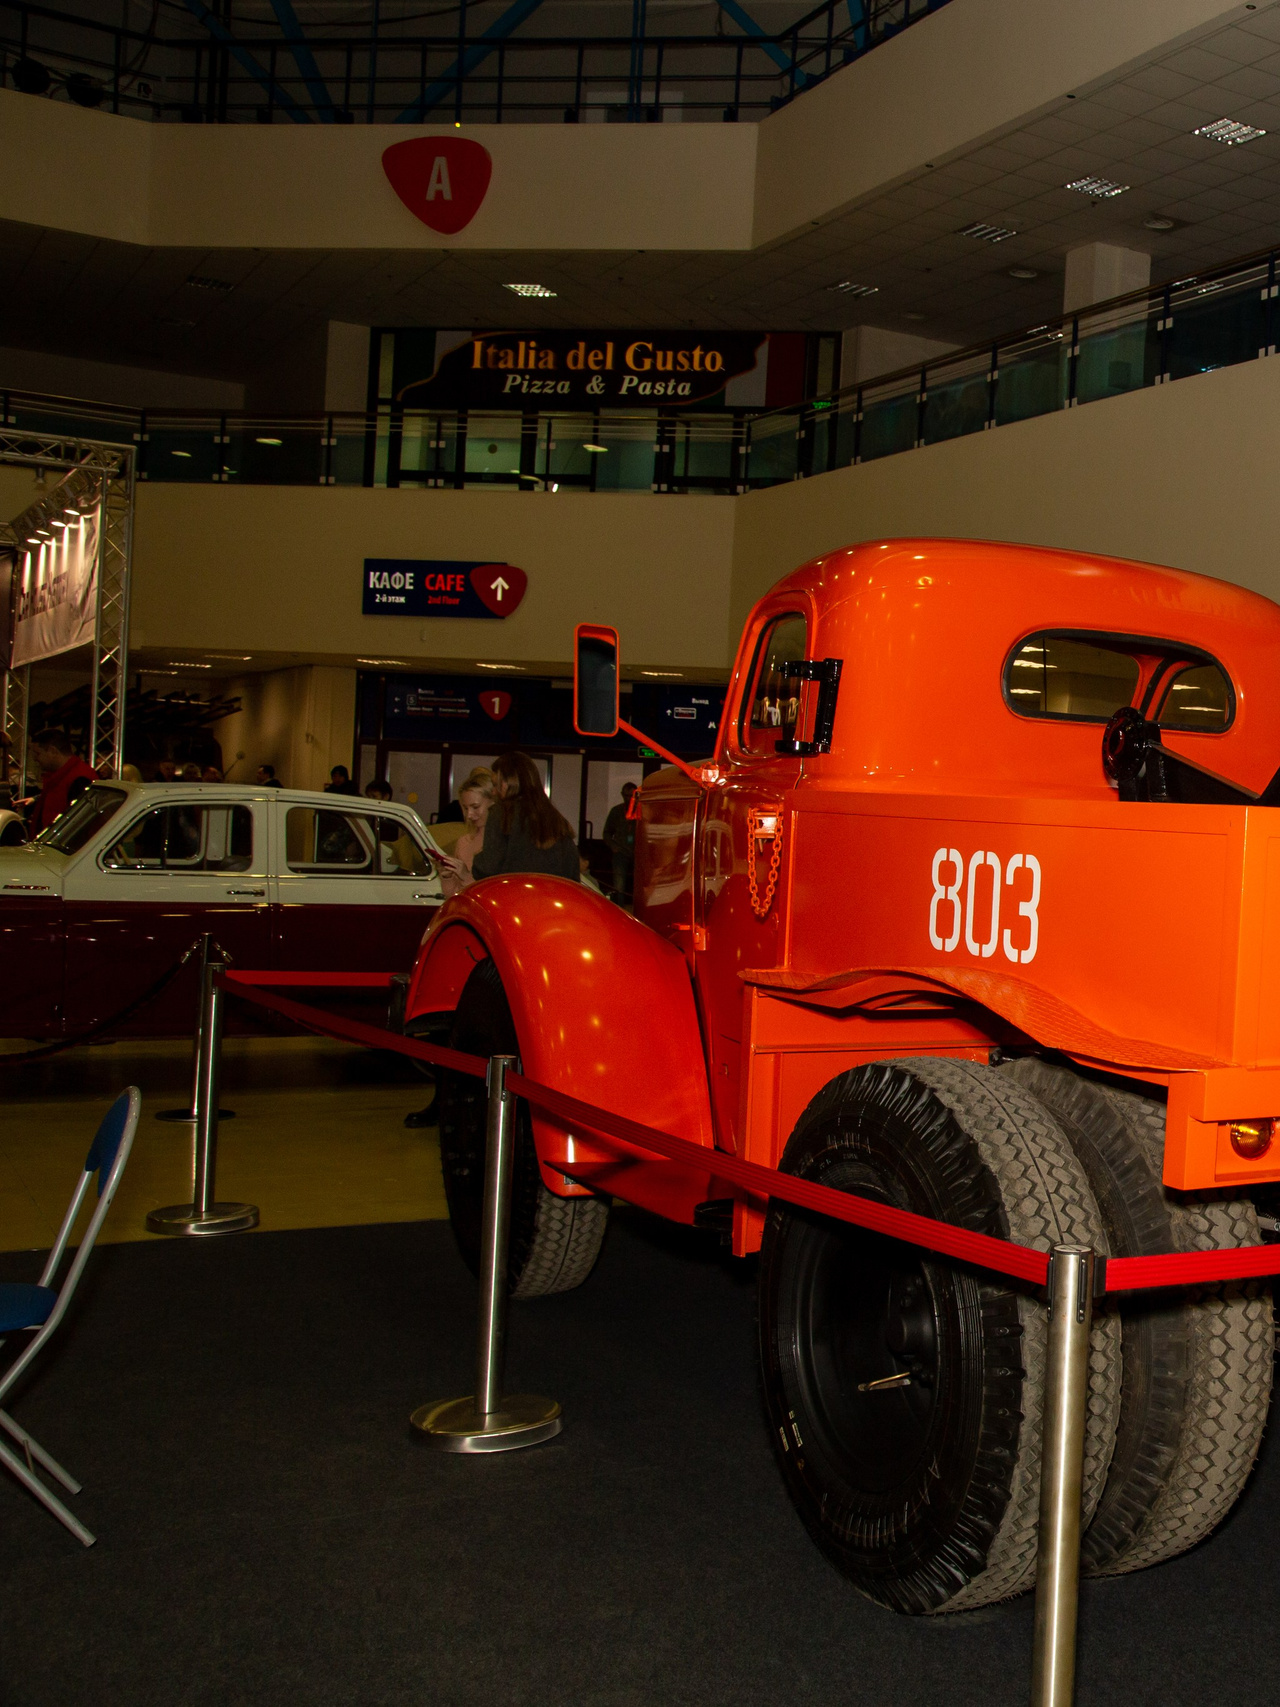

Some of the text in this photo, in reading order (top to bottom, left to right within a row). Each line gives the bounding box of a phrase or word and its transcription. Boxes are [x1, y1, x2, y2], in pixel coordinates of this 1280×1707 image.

[425, 155, 453, 202] A
[471, 340, 723, 373] Italia del Gusto
[502, 374, 692, 396] Pizza & Pasta
[369, 571, 414, 590] КАФЕ
[425, 573, 465, 592] CAFE
[491, 697, 500, 715] 1
[928, 847, 1042, 964] 803
